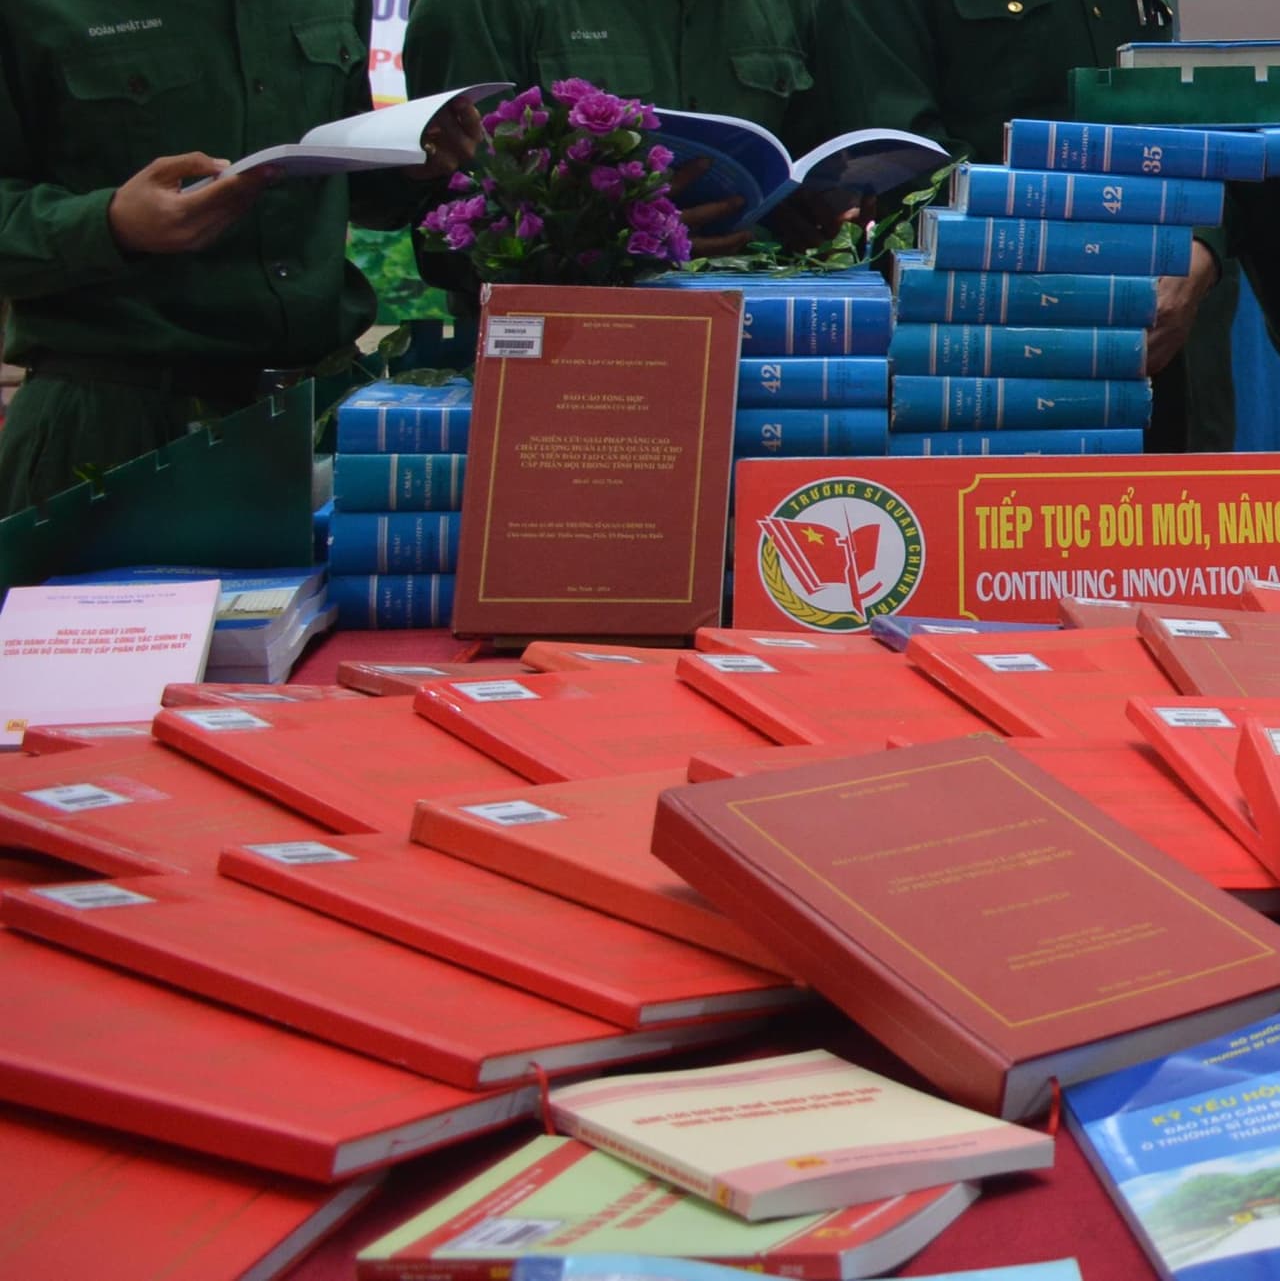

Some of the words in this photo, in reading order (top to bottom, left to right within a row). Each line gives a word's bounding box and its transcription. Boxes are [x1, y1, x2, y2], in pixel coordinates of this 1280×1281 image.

[1142, 146, 1163, 174] 35
[1102, 186, 1124, 215] 42
[1086, 243, 1100, 255] 2
[1041, 294, 1059, 307] 7
[1024, 345, 1042, 359] 7
[761, 364, 782, 394] 42
[1037, 397, 1055, 411] 7
[761, 423, 783, 452] 42
[885, 499, 917, 537] QUAN
[976, 489, 1033, 550] TIẾP
[1041, 504, 1091, 558] TỤC
[1099, 486, 1144, 547] ĐỔI
[1152, 489, 1211, 550] MỚI,
[976, 569, 1116, 602] CONTINUING
[1122, 566, 1258, 599] INNOVATION
[1190, 1095, 1238, 1115] YẾU
